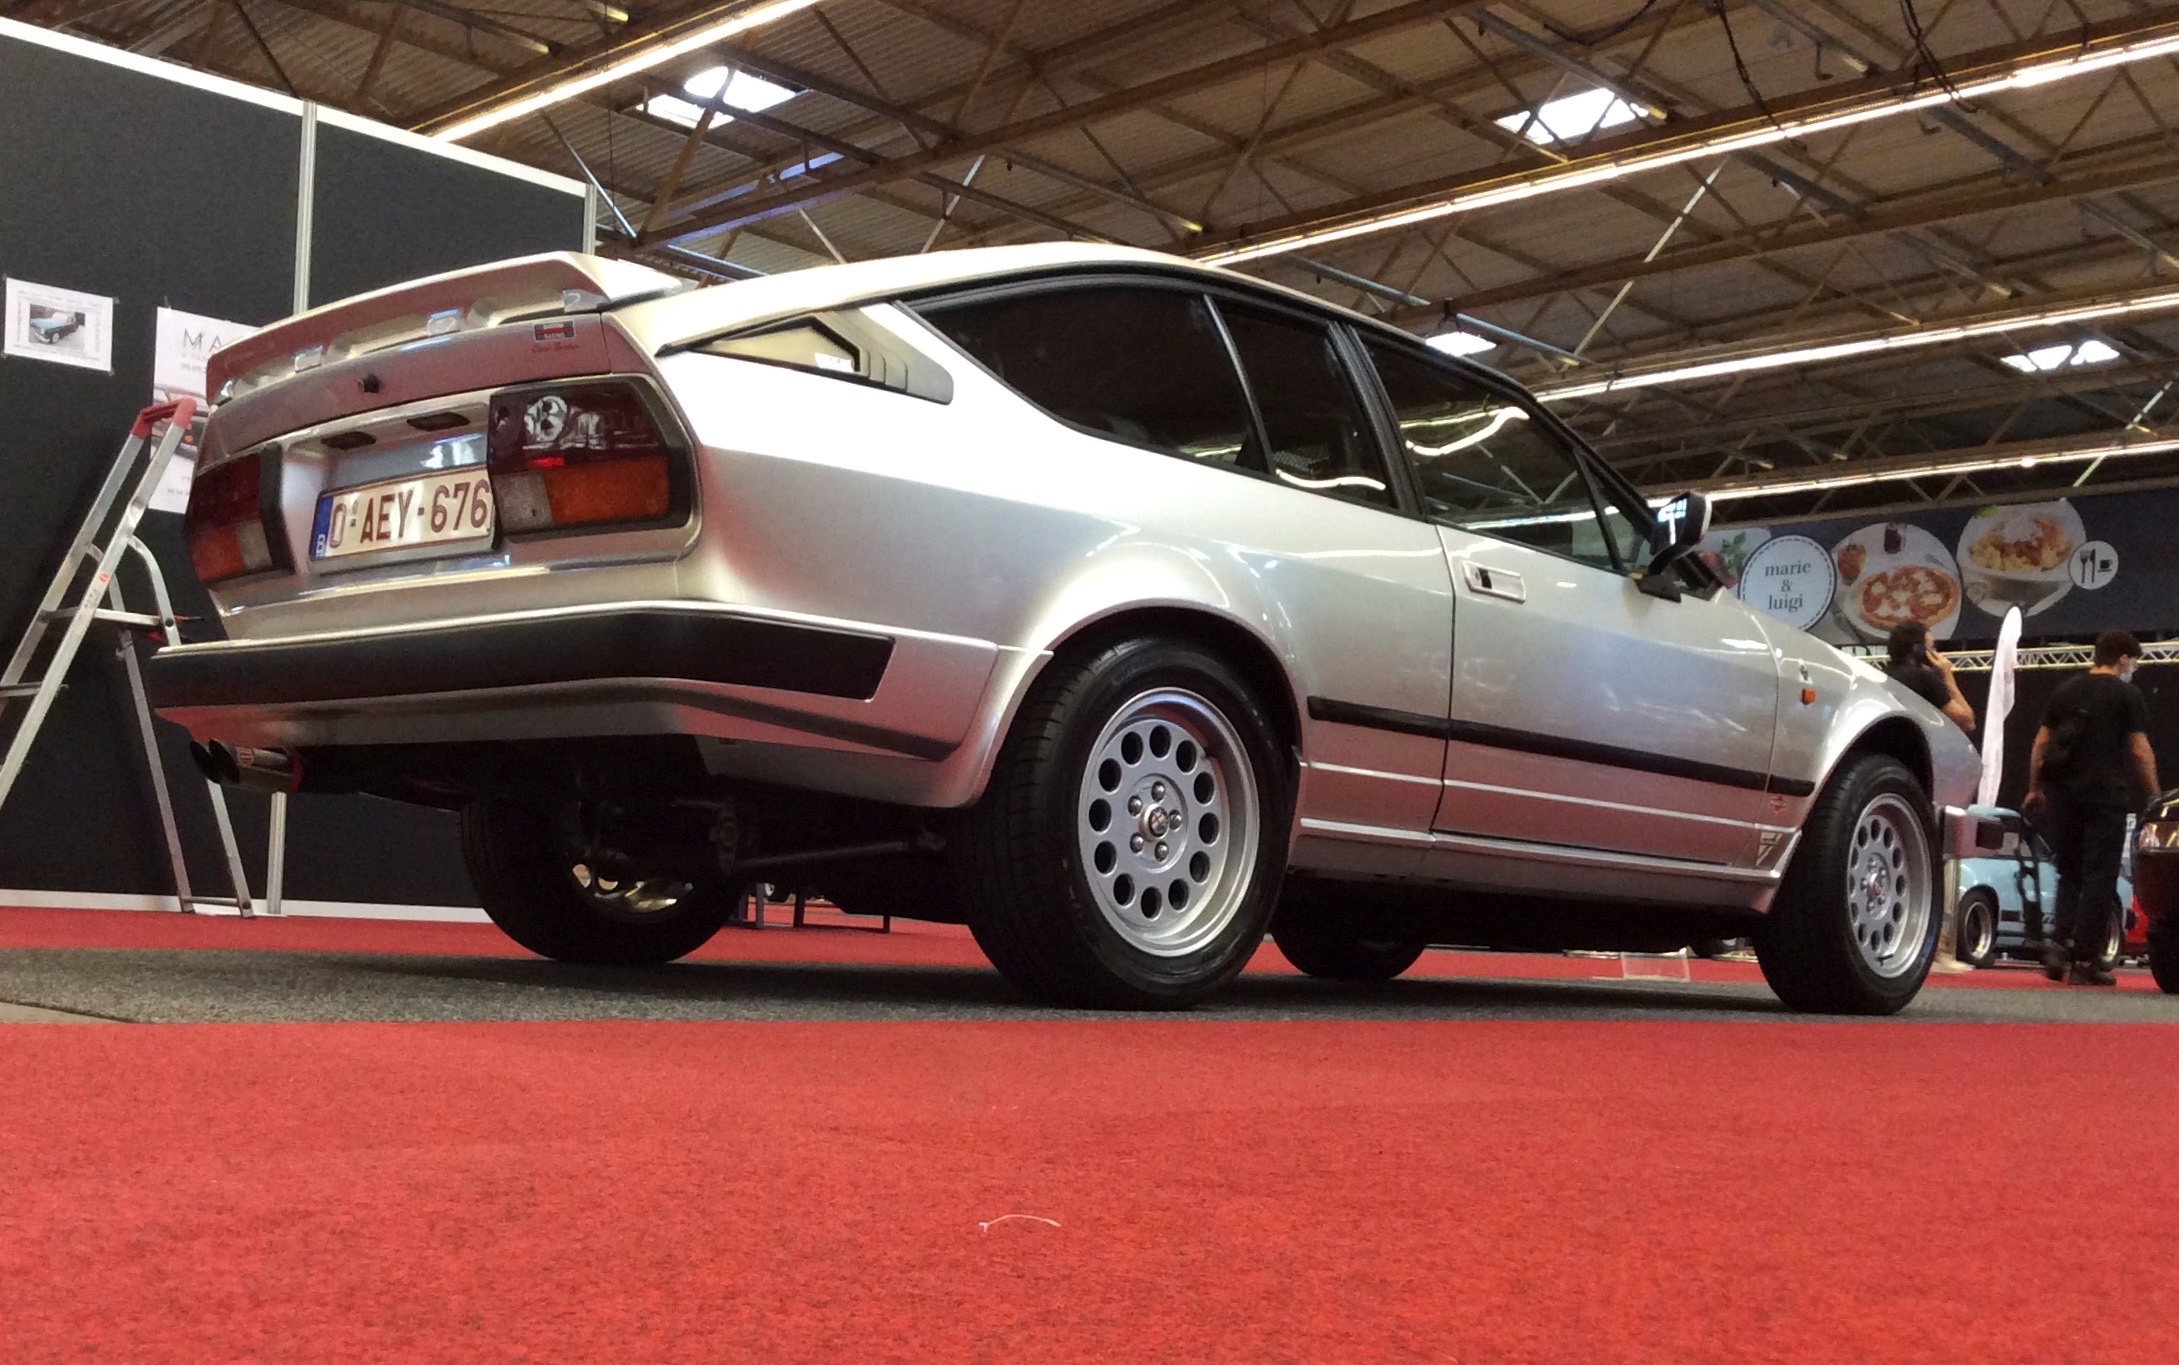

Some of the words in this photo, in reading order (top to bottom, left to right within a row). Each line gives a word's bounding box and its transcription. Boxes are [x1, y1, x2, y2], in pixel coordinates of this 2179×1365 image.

[316, 533, 327, 558] B
[1764, 560, 1812, 577] marie
[1781, 578, 1792, 592] &
[1768, 593, 1804, 613] luigi
